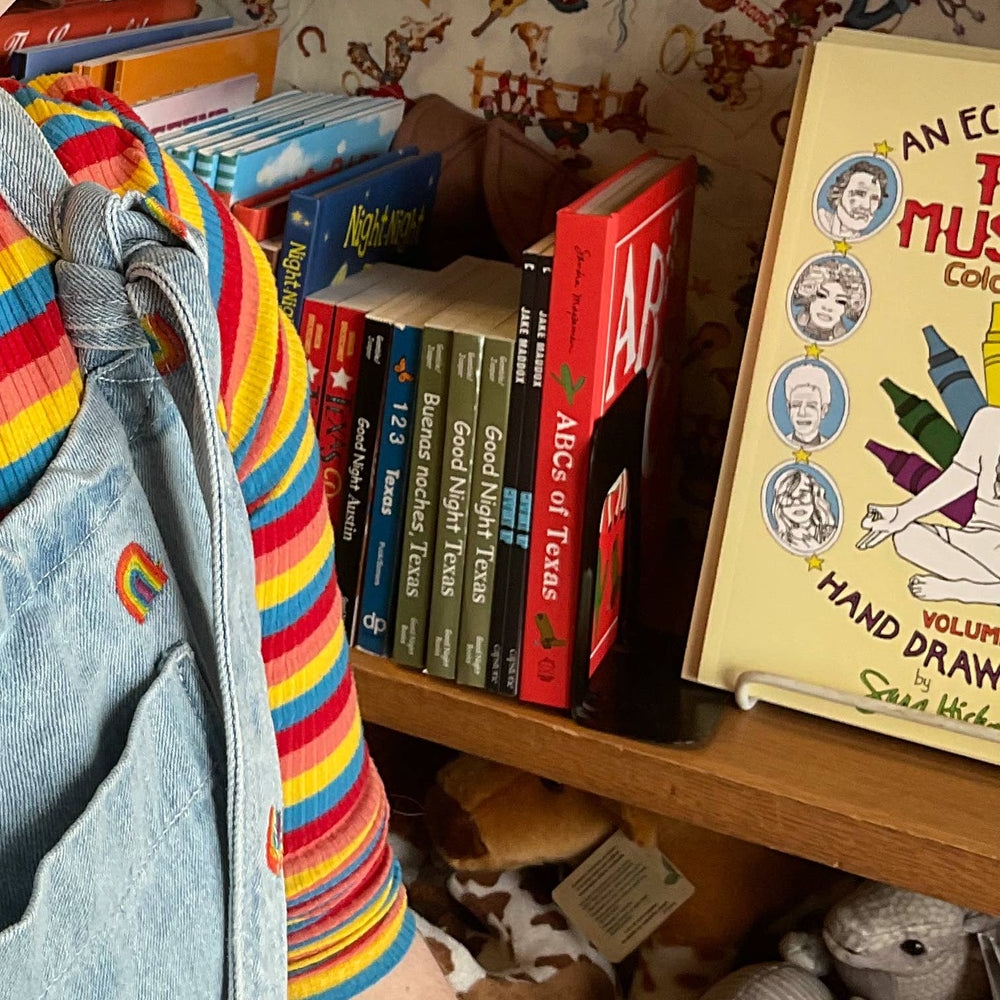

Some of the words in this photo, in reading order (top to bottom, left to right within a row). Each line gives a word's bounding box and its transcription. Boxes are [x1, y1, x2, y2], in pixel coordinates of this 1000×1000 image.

[902, 118, 950, 161] AN
[519, 306, 531, 335] JAKE
[537, 310, 548, 339] JAKE
[515, 337, 530, 384] MADDOX
[354, 417, 370, 452] Good
[418, 392, 441, 461] Buenas
[451, 421, 471, 472] Good
[483, 425, 502, 477] Good
[552, 410, 579, 482] ABCs
[347, 452, 366, 492] Night
[381, 468, 400, 516] Texas
[342, 494, 361, 541] Austin
[408, 465, 431, 537] noches,
[443, 474, 467, 533] Night
[474, 483, 497, 540] Night
[548, 491, 569, 518] of
[406, 541, 428, 598] Texas
[441, 540, 463, 597] Texas
[472, 545, 495, 604] Texas
[542, 527, 570, 601] Texas
[817, 571, 900, 640] HAND
[915, 669, 931, 693] by
